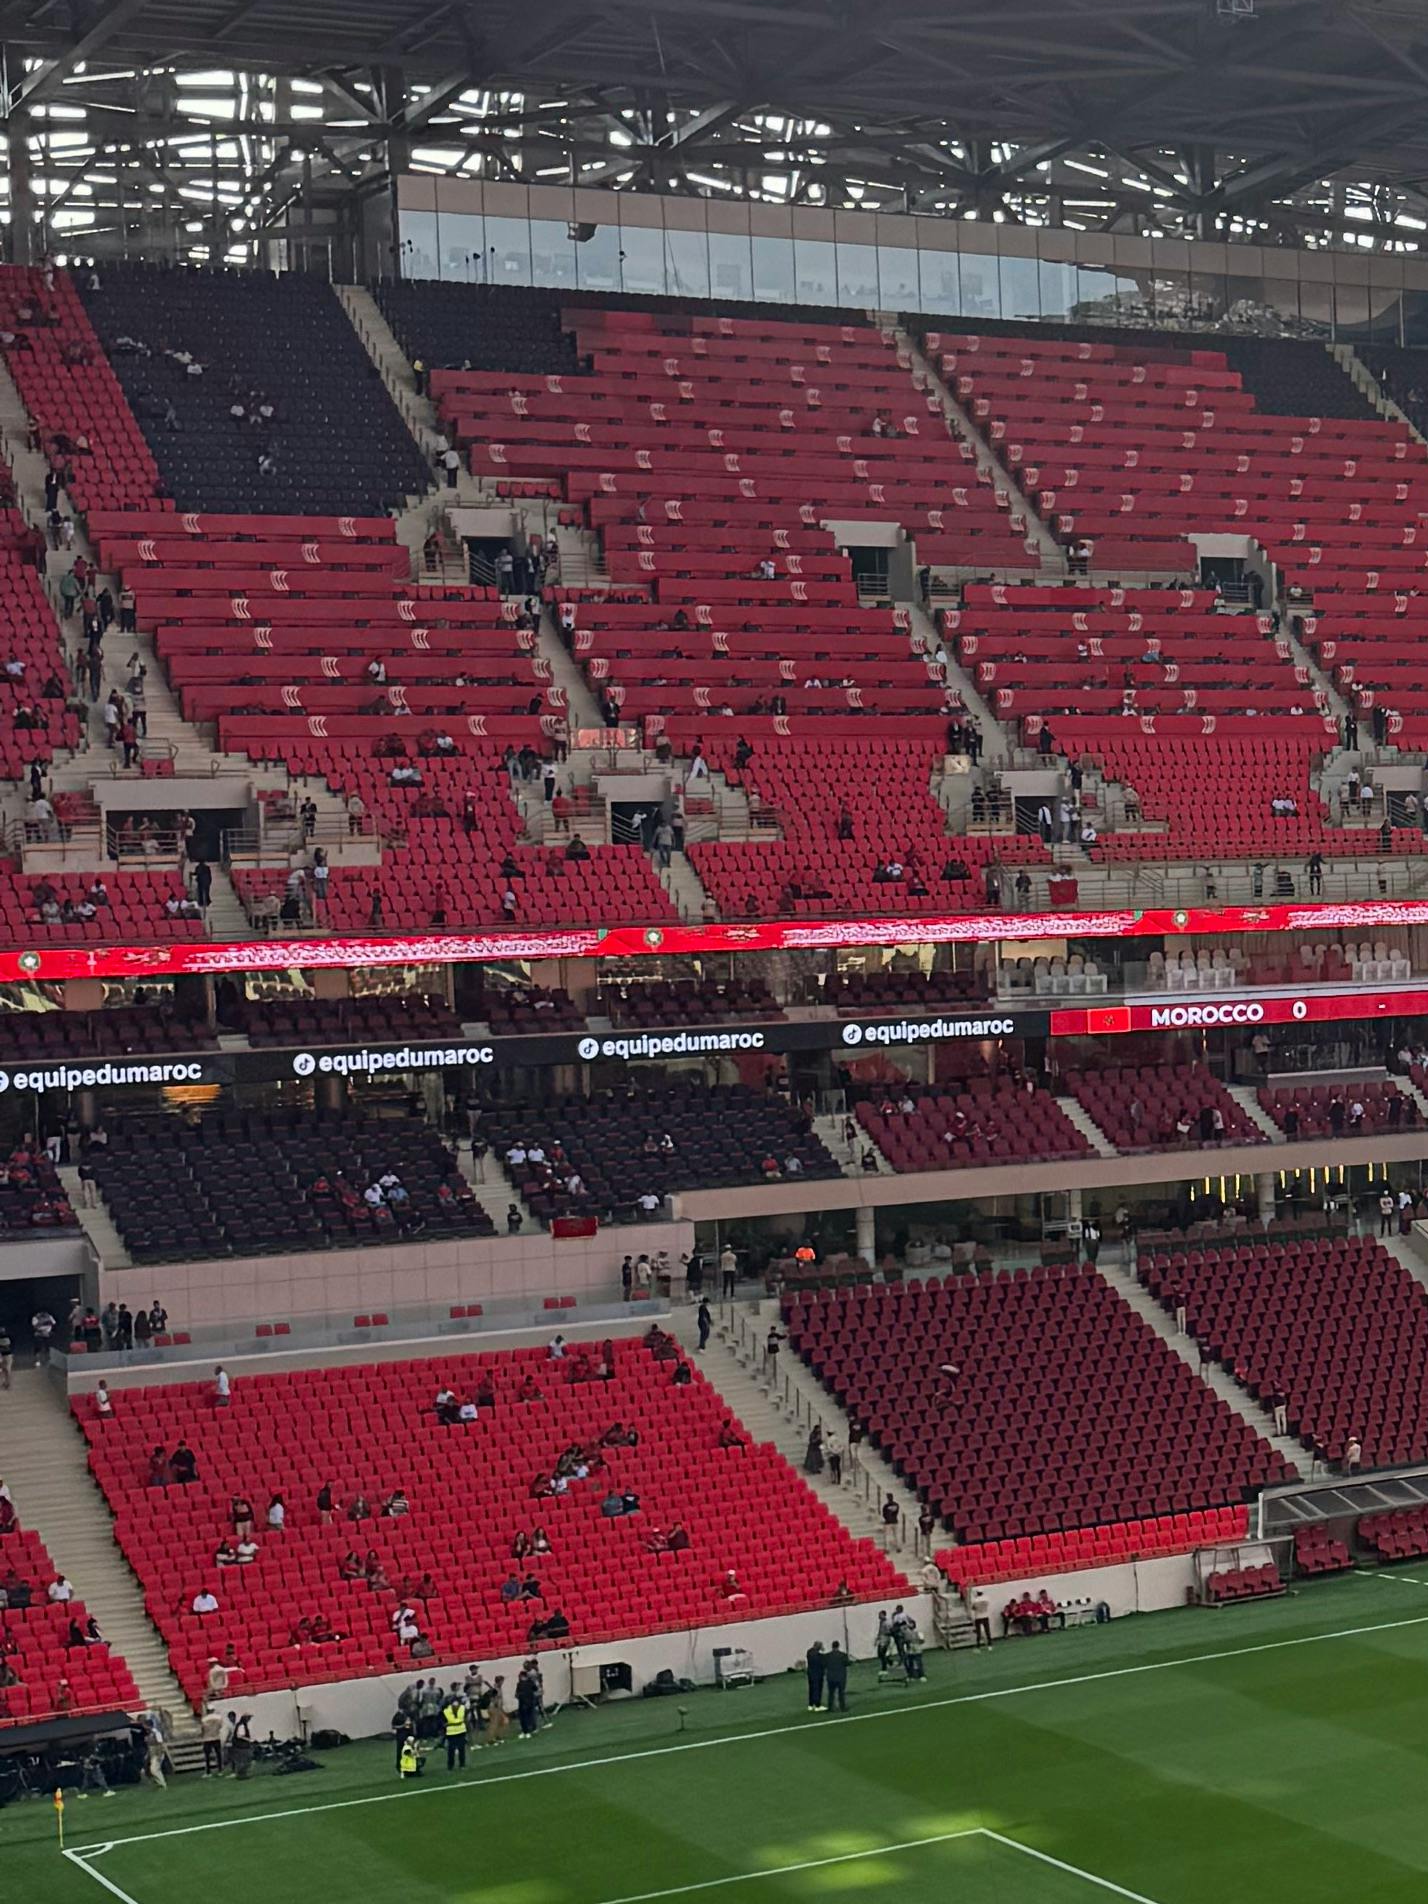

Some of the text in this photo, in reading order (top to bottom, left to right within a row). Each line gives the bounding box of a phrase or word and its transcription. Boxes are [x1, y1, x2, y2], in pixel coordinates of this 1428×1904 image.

[1151, 1003, 1264, 1027] MOROCCO
[1292, 1000, 1307, 1019] 0
[864, 1018, 1014, 1045] equipedumaroc
[602, 1032, 765, 1060] equipedumaroc
[318, 1047, 494, 1076] equipedumaroc
[13, 1063, 202, 1093] equipedumaroc
